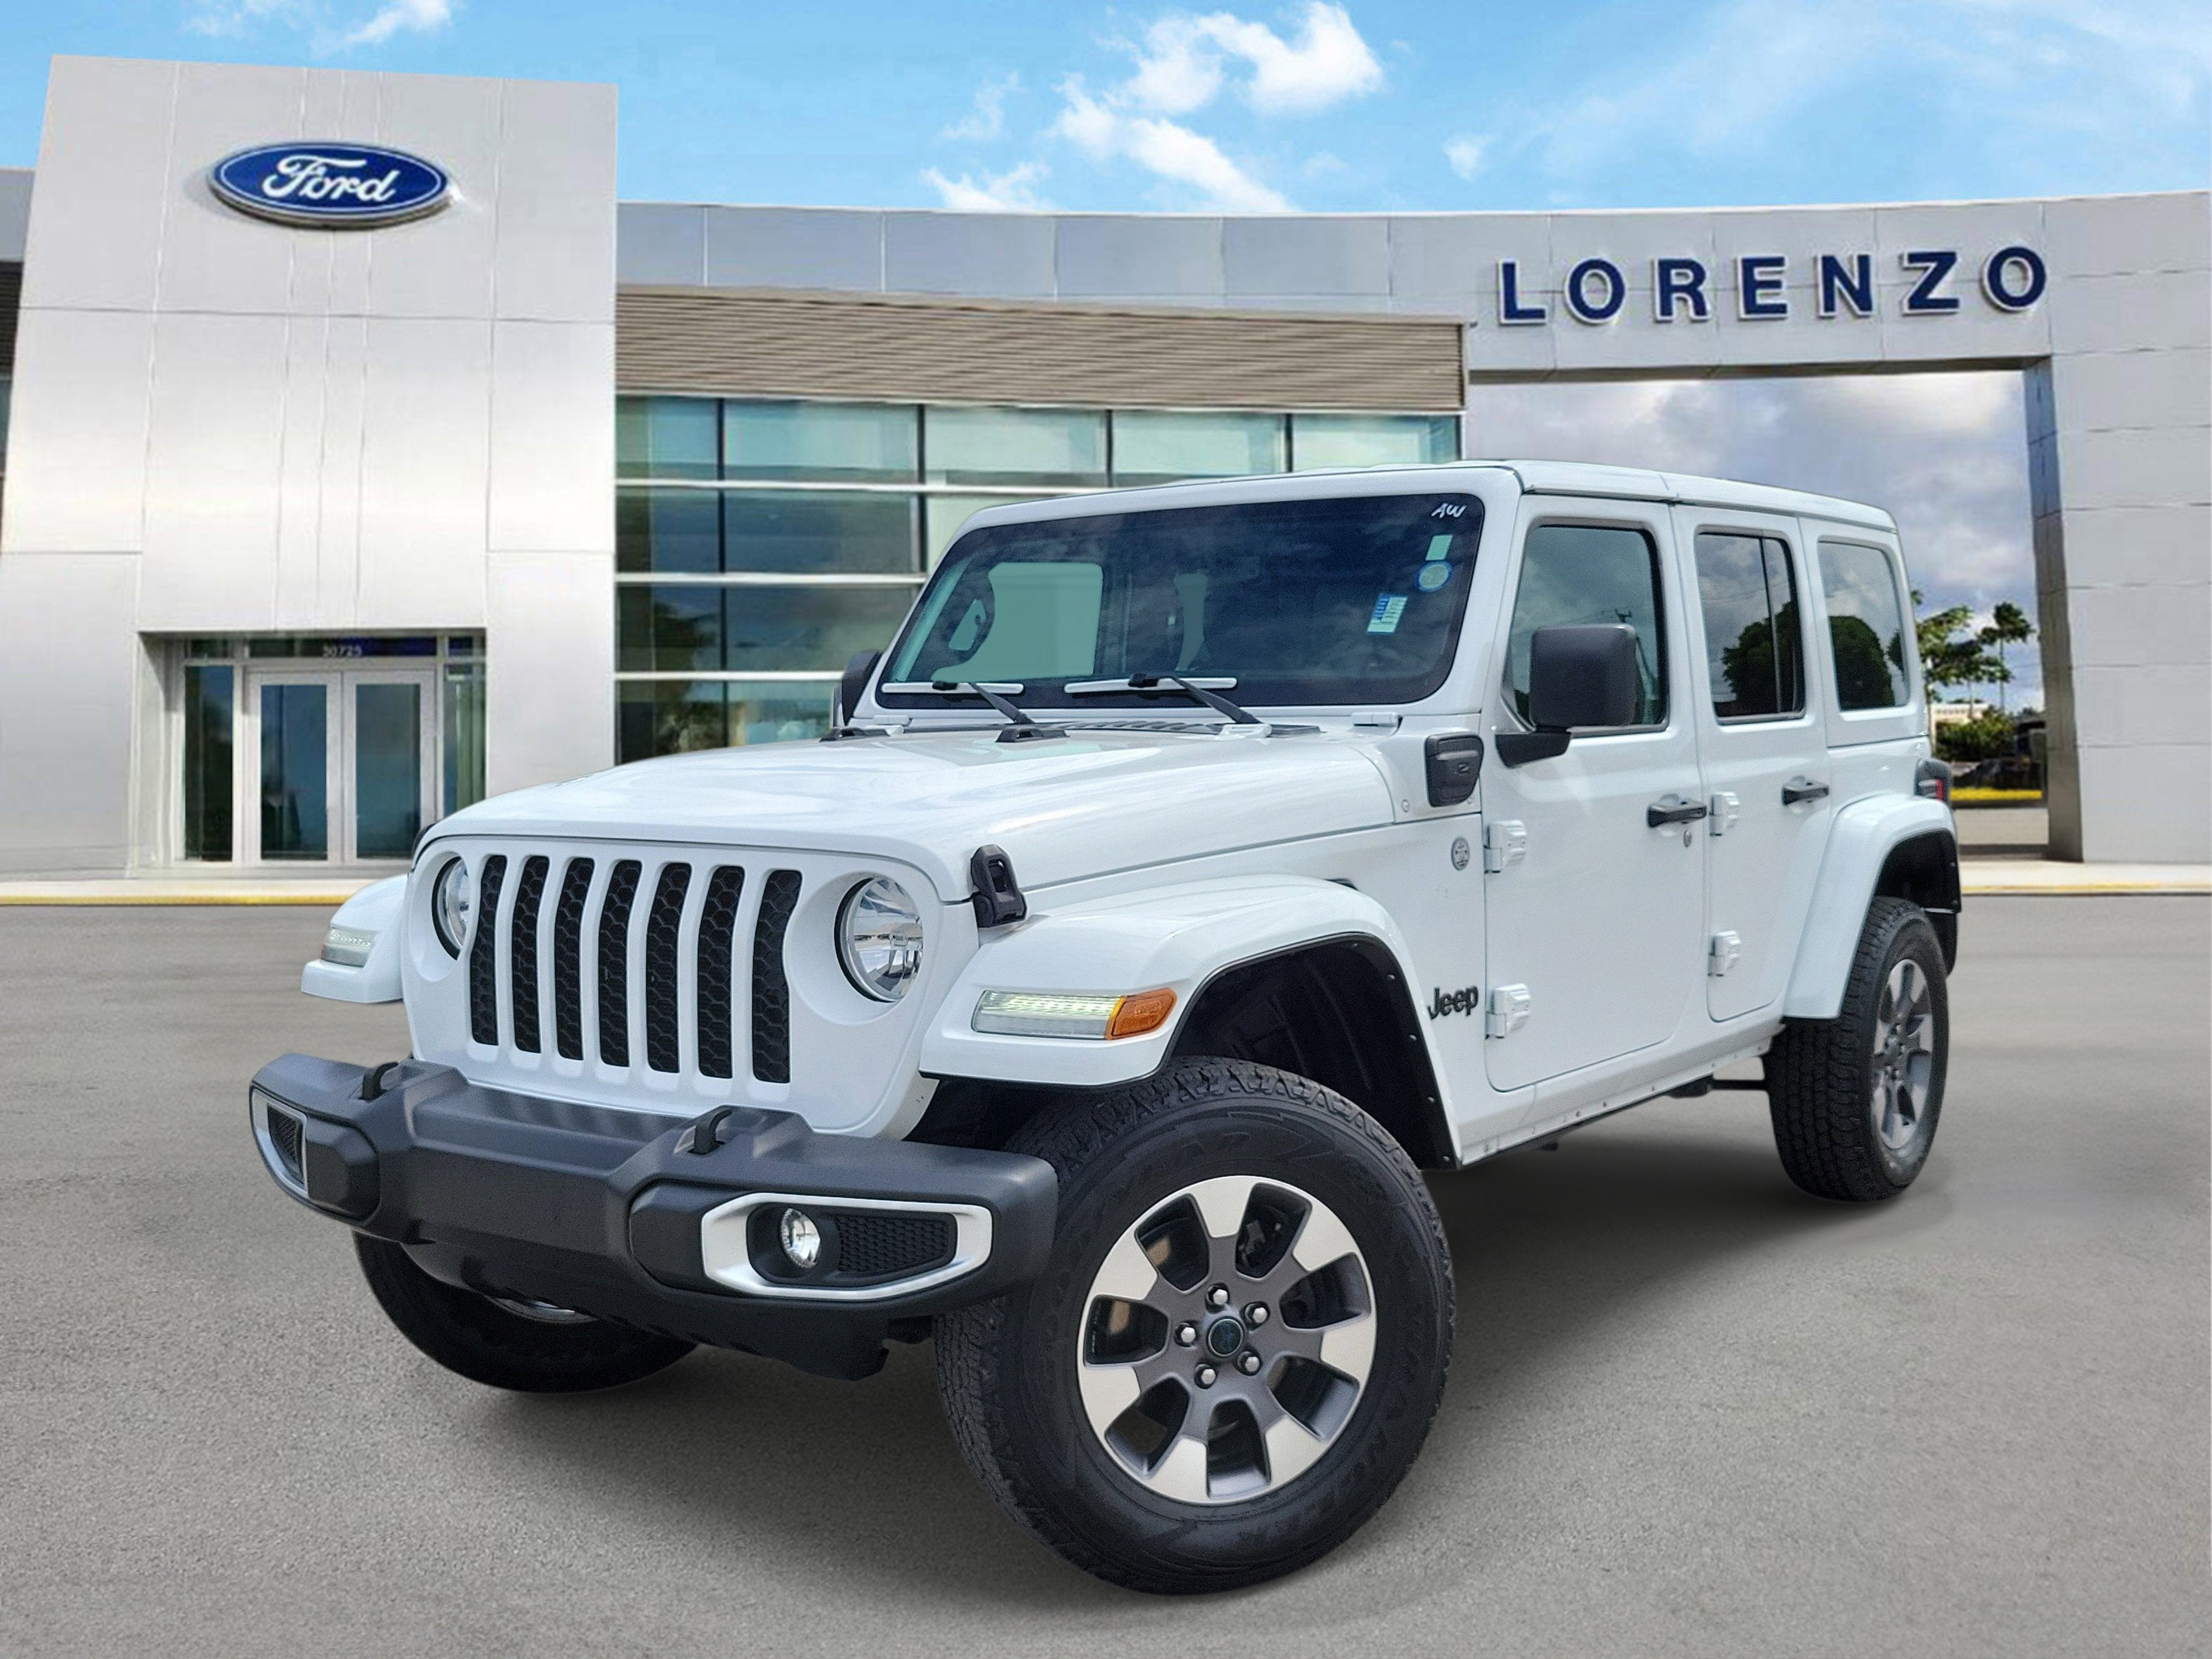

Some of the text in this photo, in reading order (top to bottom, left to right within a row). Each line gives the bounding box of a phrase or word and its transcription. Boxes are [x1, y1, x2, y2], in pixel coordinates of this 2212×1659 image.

[262, 155, 400, 202] Ford
[1497, 246, 2047, 324] LORENZO
[1427, 986, 1479, 1020] Jeep
